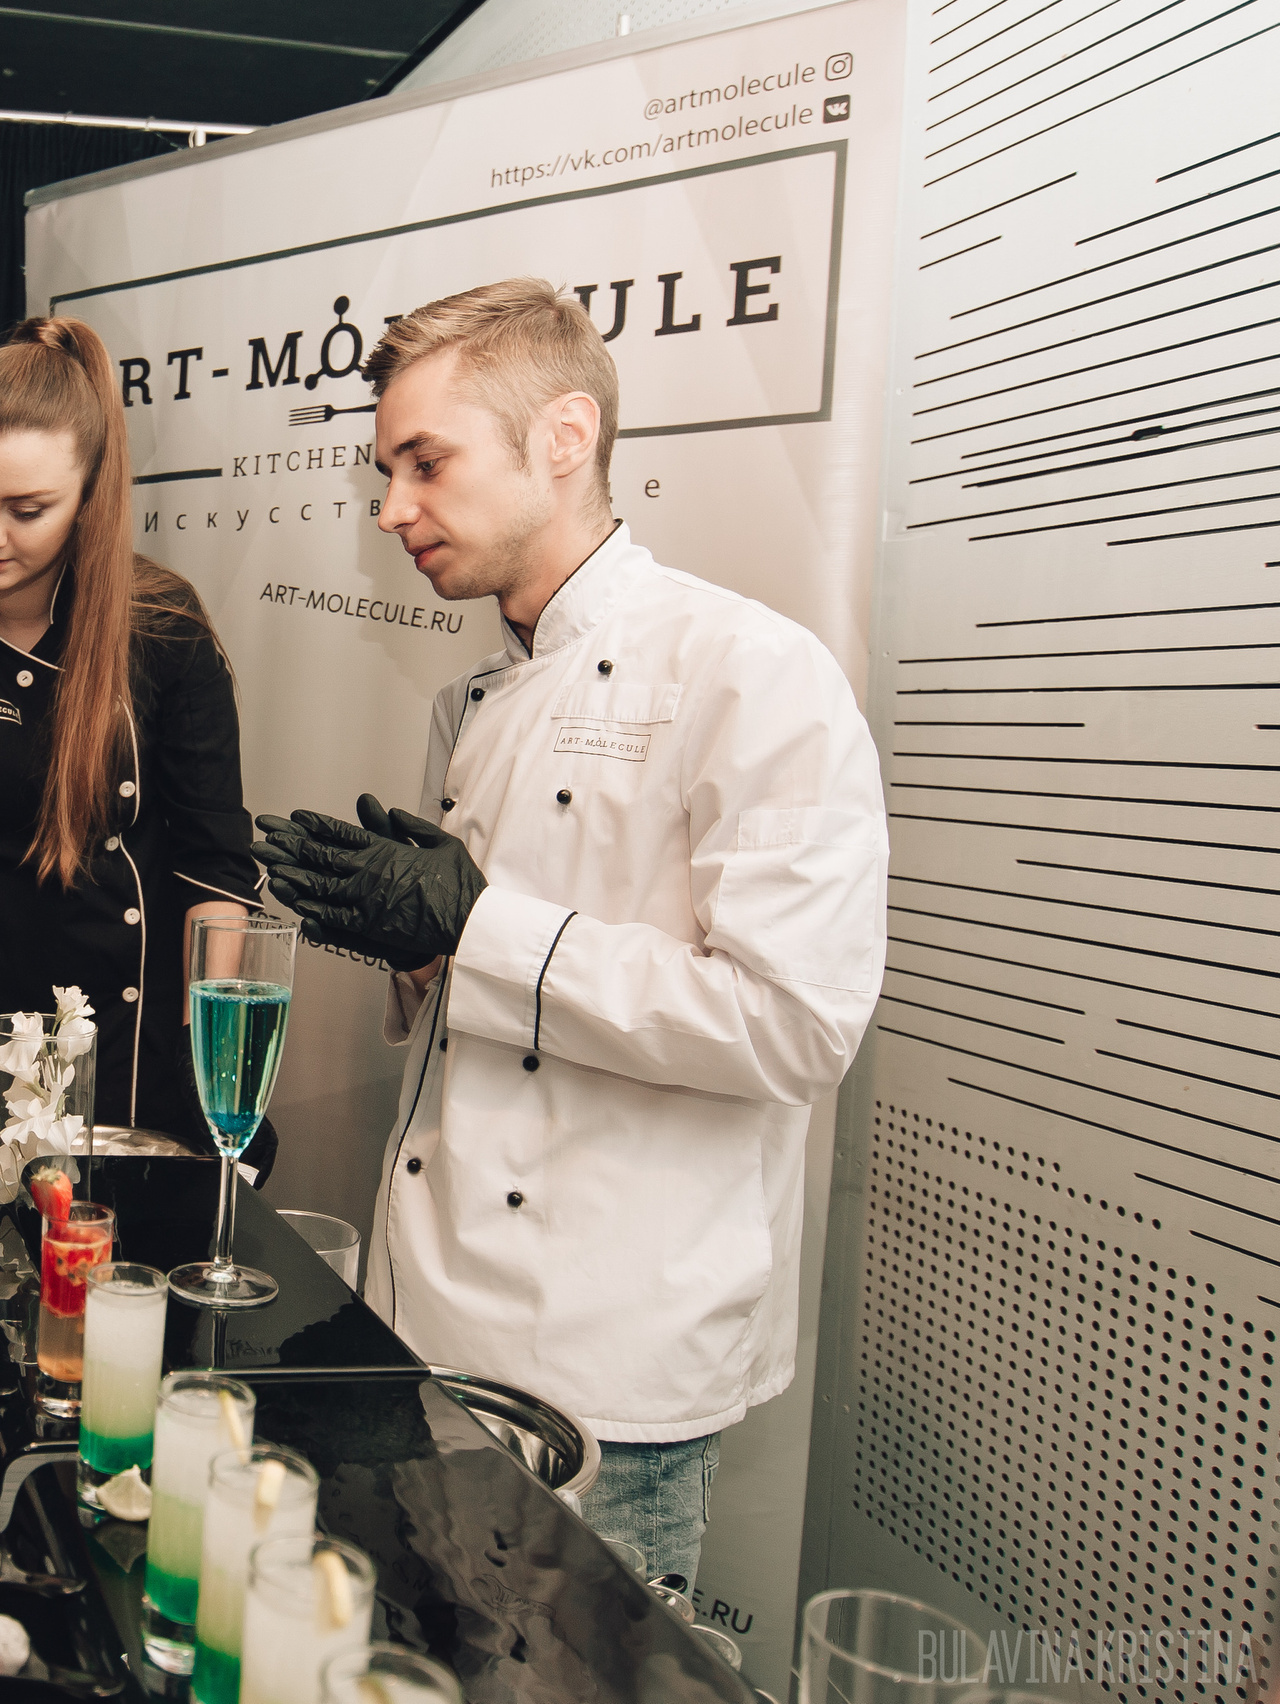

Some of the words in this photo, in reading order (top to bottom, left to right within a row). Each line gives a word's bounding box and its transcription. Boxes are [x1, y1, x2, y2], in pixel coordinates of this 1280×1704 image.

[643, 62, 816, 121] @artmolecule
[490, 104, 814, 188] https://vk.com/artmolecule
[232, 443, 373, 478] KITCHEN
[144, 499, 382, 532] Искусств
[259, 582, 464, 635] ART-MOLECULE.RU
[559, 736, 646, 754] ART-MOLECULE
